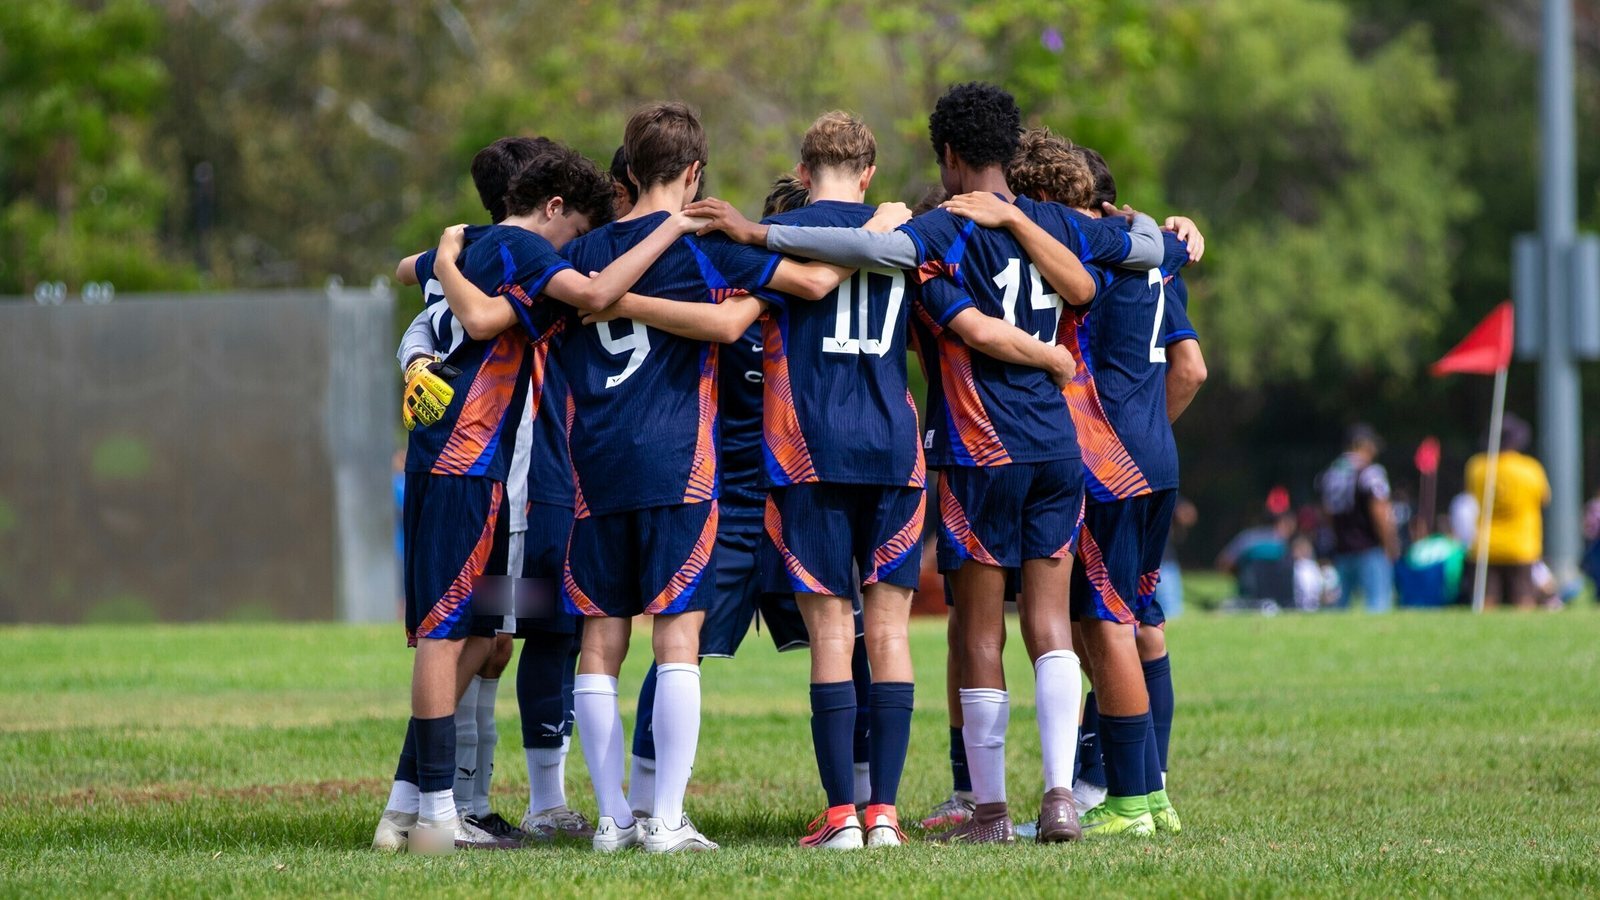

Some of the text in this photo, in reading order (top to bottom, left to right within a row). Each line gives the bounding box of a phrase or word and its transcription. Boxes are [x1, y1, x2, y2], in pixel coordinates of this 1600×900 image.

[822, 266, 906, 358] 10
[992, 257, 1064, 347] 15
[1148, 267, 1167, 363] 2
[596, 319, 651, 389] 9
